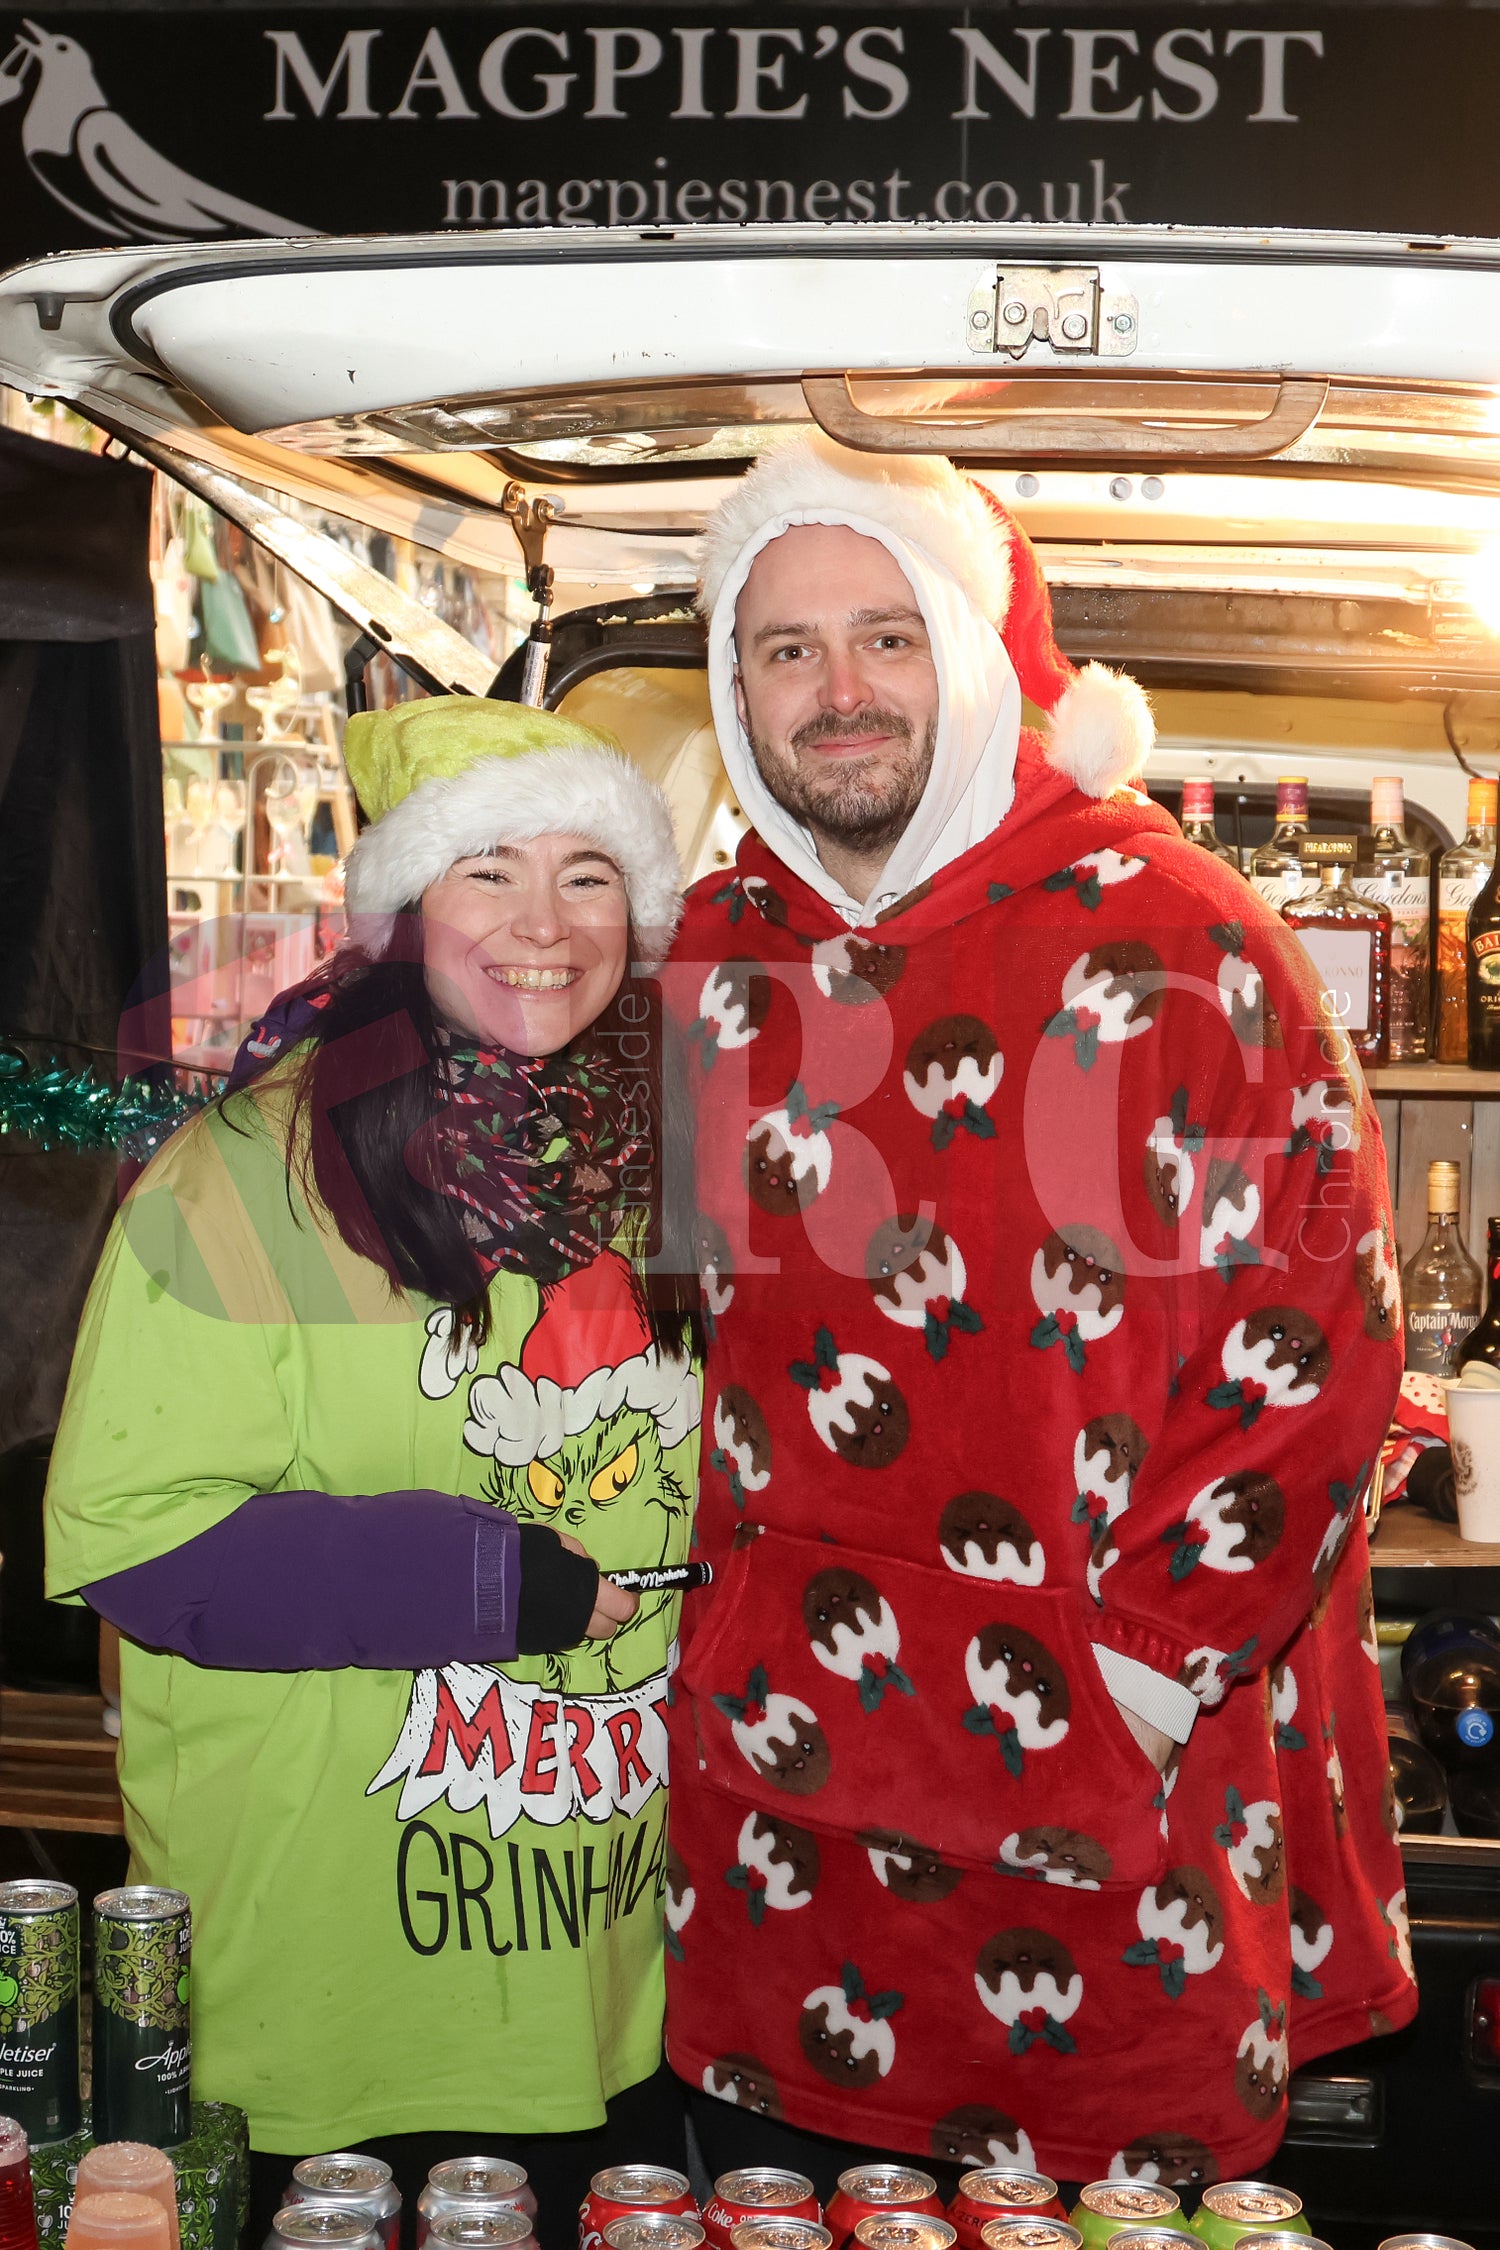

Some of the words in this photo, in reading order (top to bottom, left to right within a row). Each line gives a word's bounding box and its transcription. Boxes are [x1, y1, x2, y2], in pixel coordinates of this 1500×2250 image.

[263, 25, 910, 121] MAGPIE’S
[949, 26, 1325, 123] NEST
[441, 156, 1133, 226] magpiesnest.co.uk
[1409, 1311, 1448, 1333] Captain
[16, 2069, 43, 2078] JUICE
[707, 2202, 733, 2229] Coke
